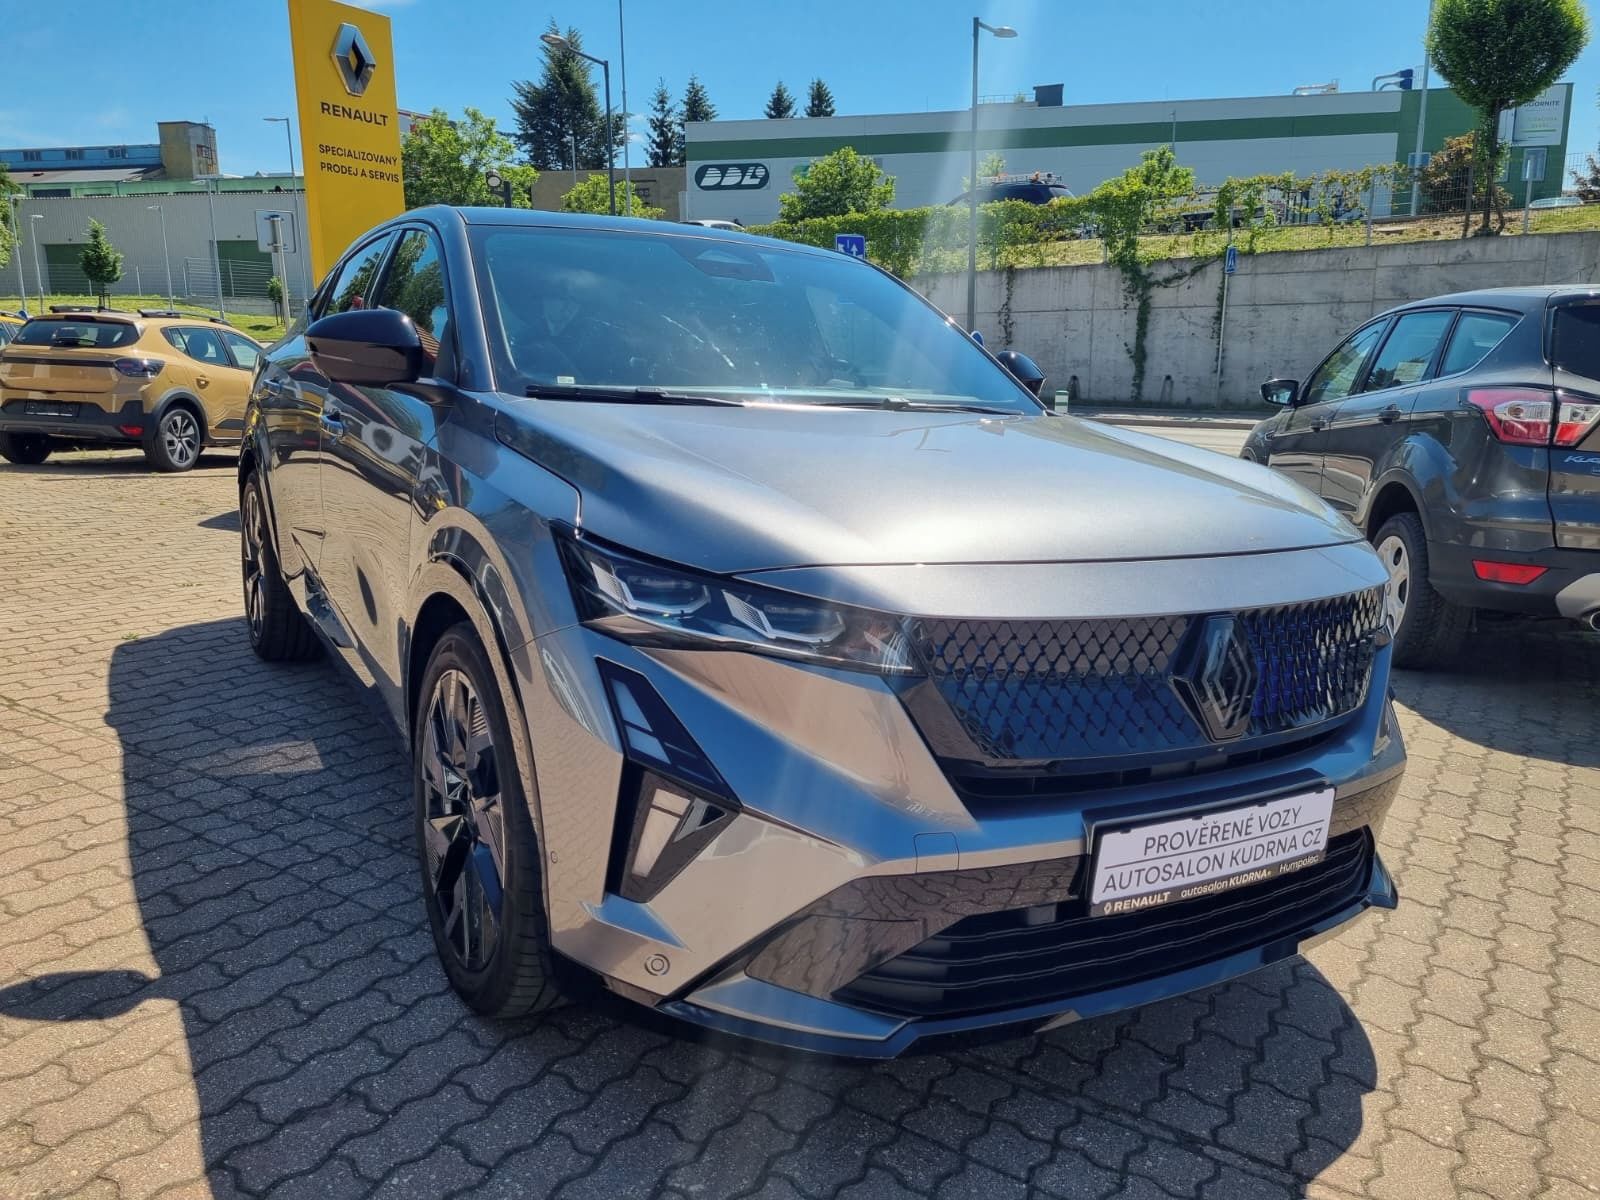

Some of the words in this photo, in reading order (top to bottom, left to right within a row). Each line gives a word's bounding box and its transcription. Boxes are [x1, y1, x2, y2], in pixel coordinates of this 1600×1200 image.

[320, 101, 388, 126] RENAULT
[320, 161, 359, 177] PRODEJ
[360, 167, 367, 178] A
[368, 169, 400, 183] SERVIS
[1143, 814, 1254, 856] PROVĚŘENÉ
[1258, 805, 1303, 832] VOZY
[1102, 850, 1225, 894] AUTOSALON
[1228, 834, 1298, 868] KUDRNA
[1301, 827, 1324, 849] CZ
[1113, 891, 1171, 913] RENAULT
[1180, 879, 1228, 898] autosalon
[1279, 854, 1320, 874] Humpolec
